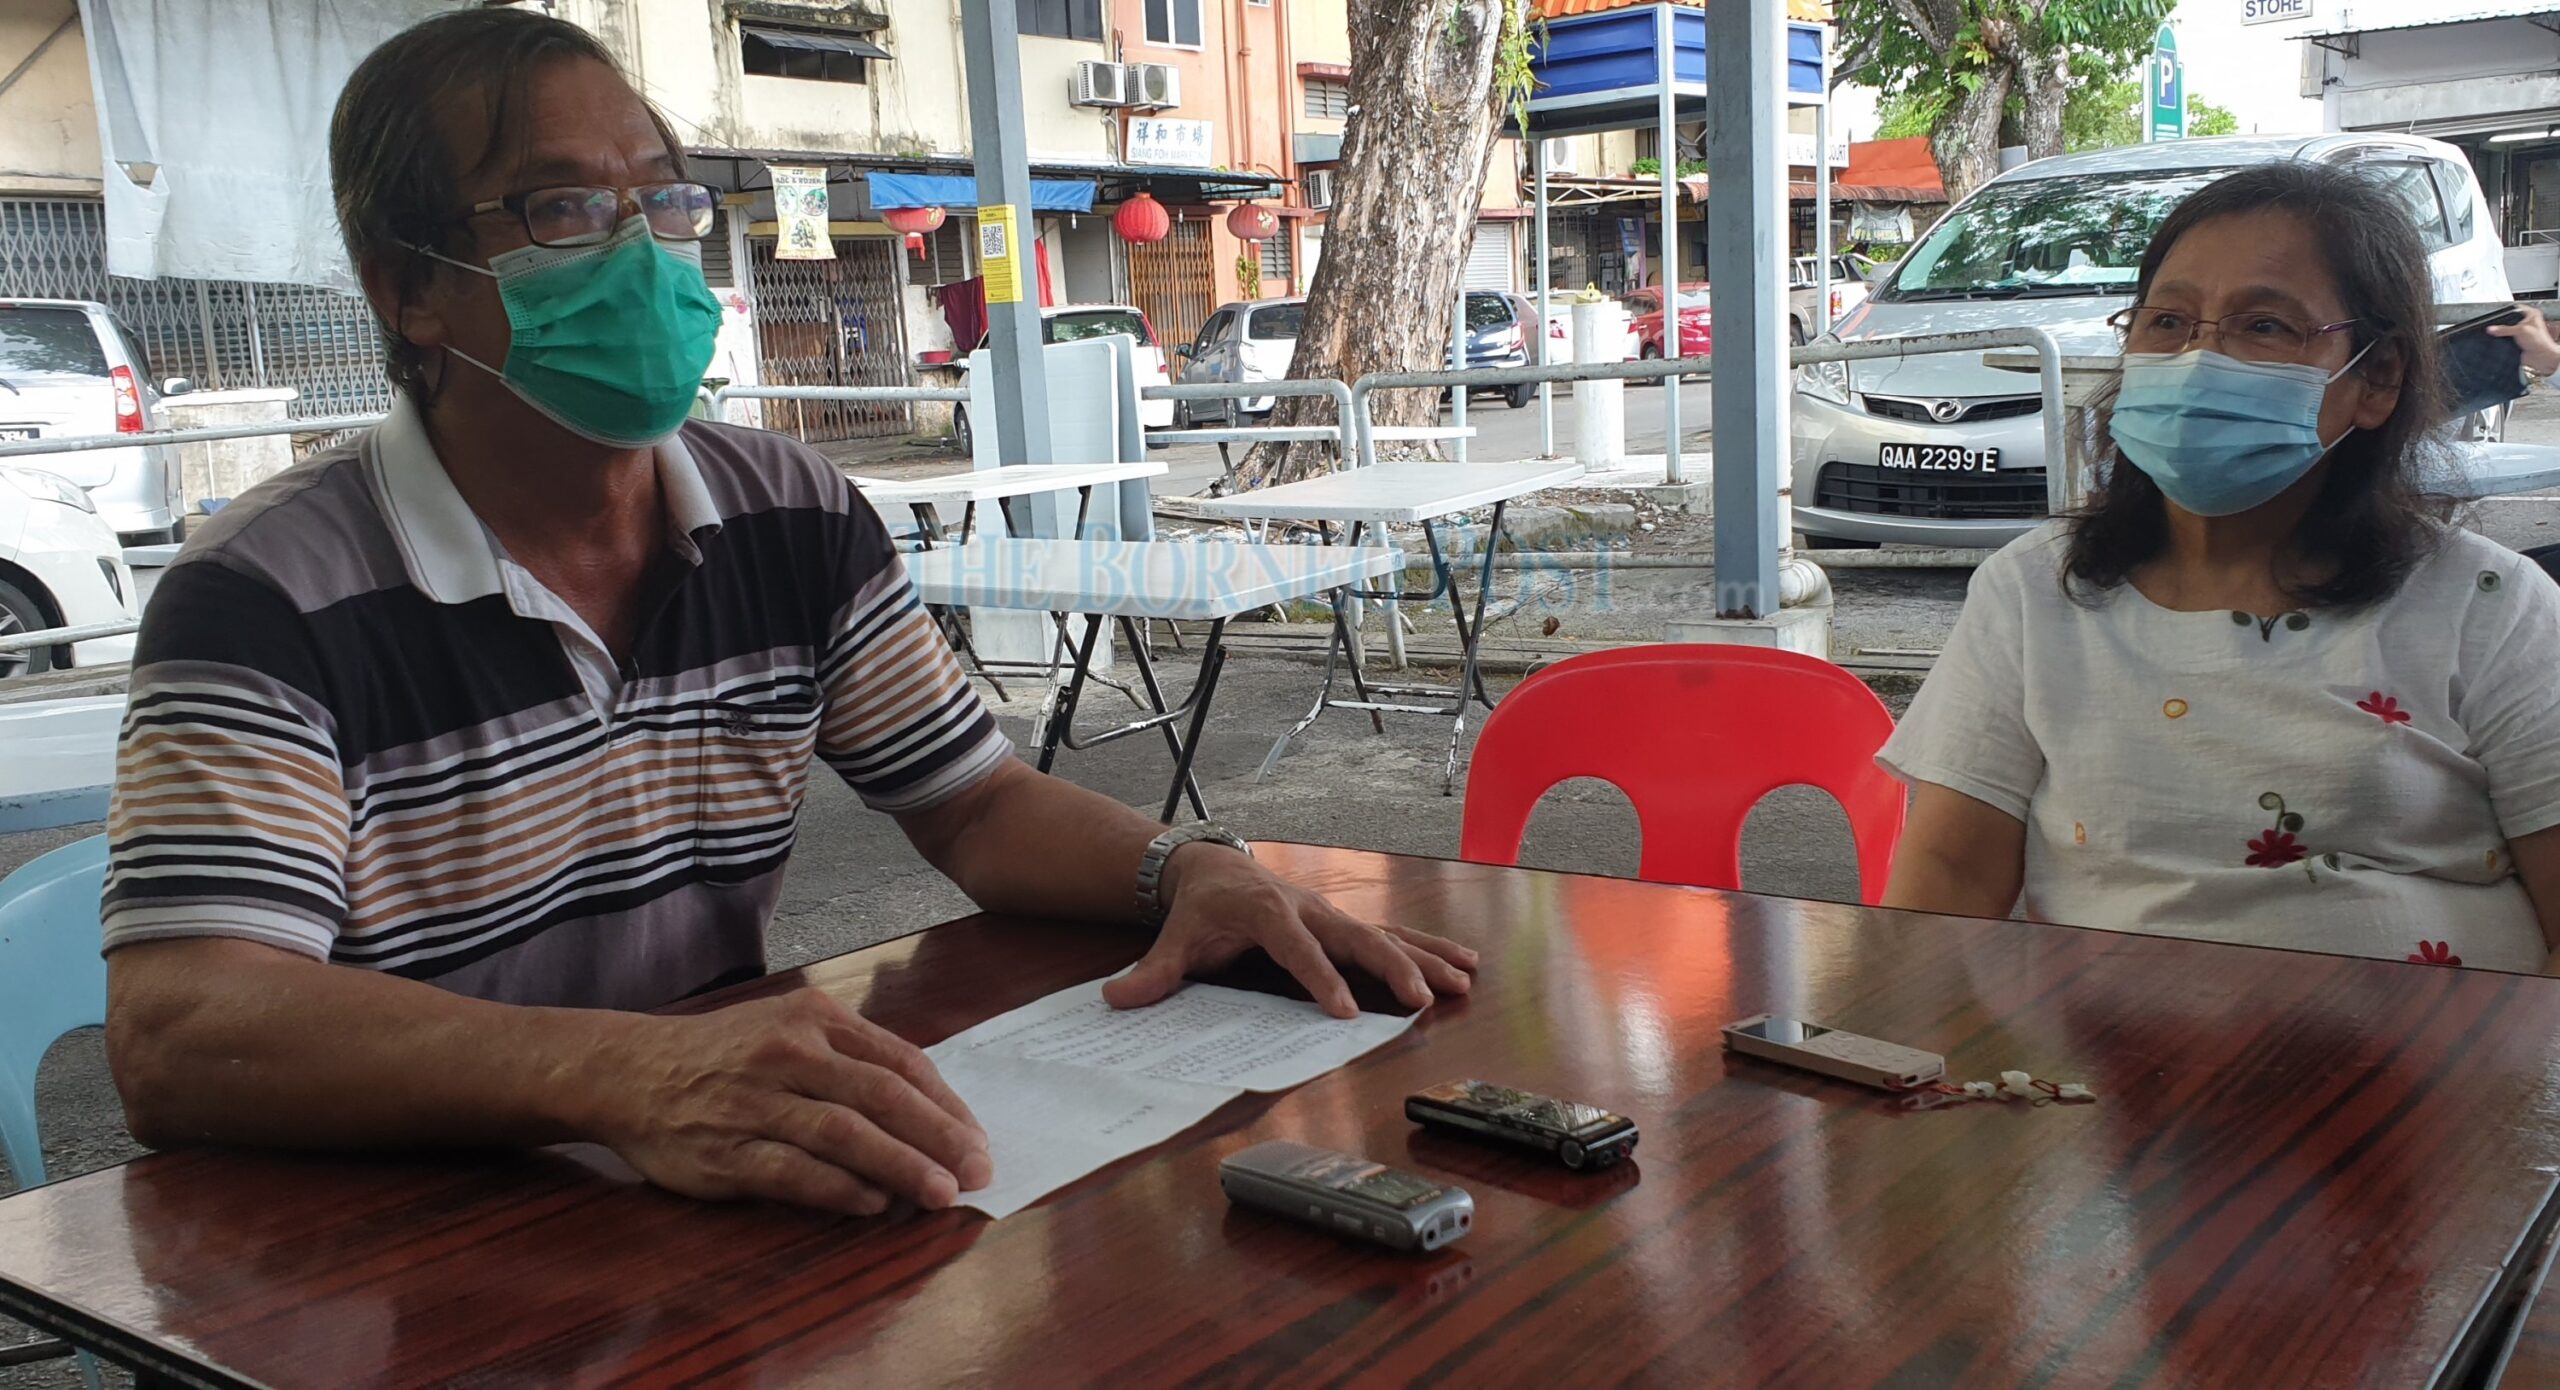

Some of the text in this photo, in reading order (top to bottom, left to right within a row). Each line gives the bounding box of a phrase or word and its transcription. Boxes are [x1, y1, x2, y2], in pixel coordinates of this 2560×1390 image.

[2245, 0, 2303, 18] STORE
[2160, 56, 2173, 97] P
[1131, 147, 1152, 159] SIANG
[1881, 446, 1997, 473] QAA 2299 E
